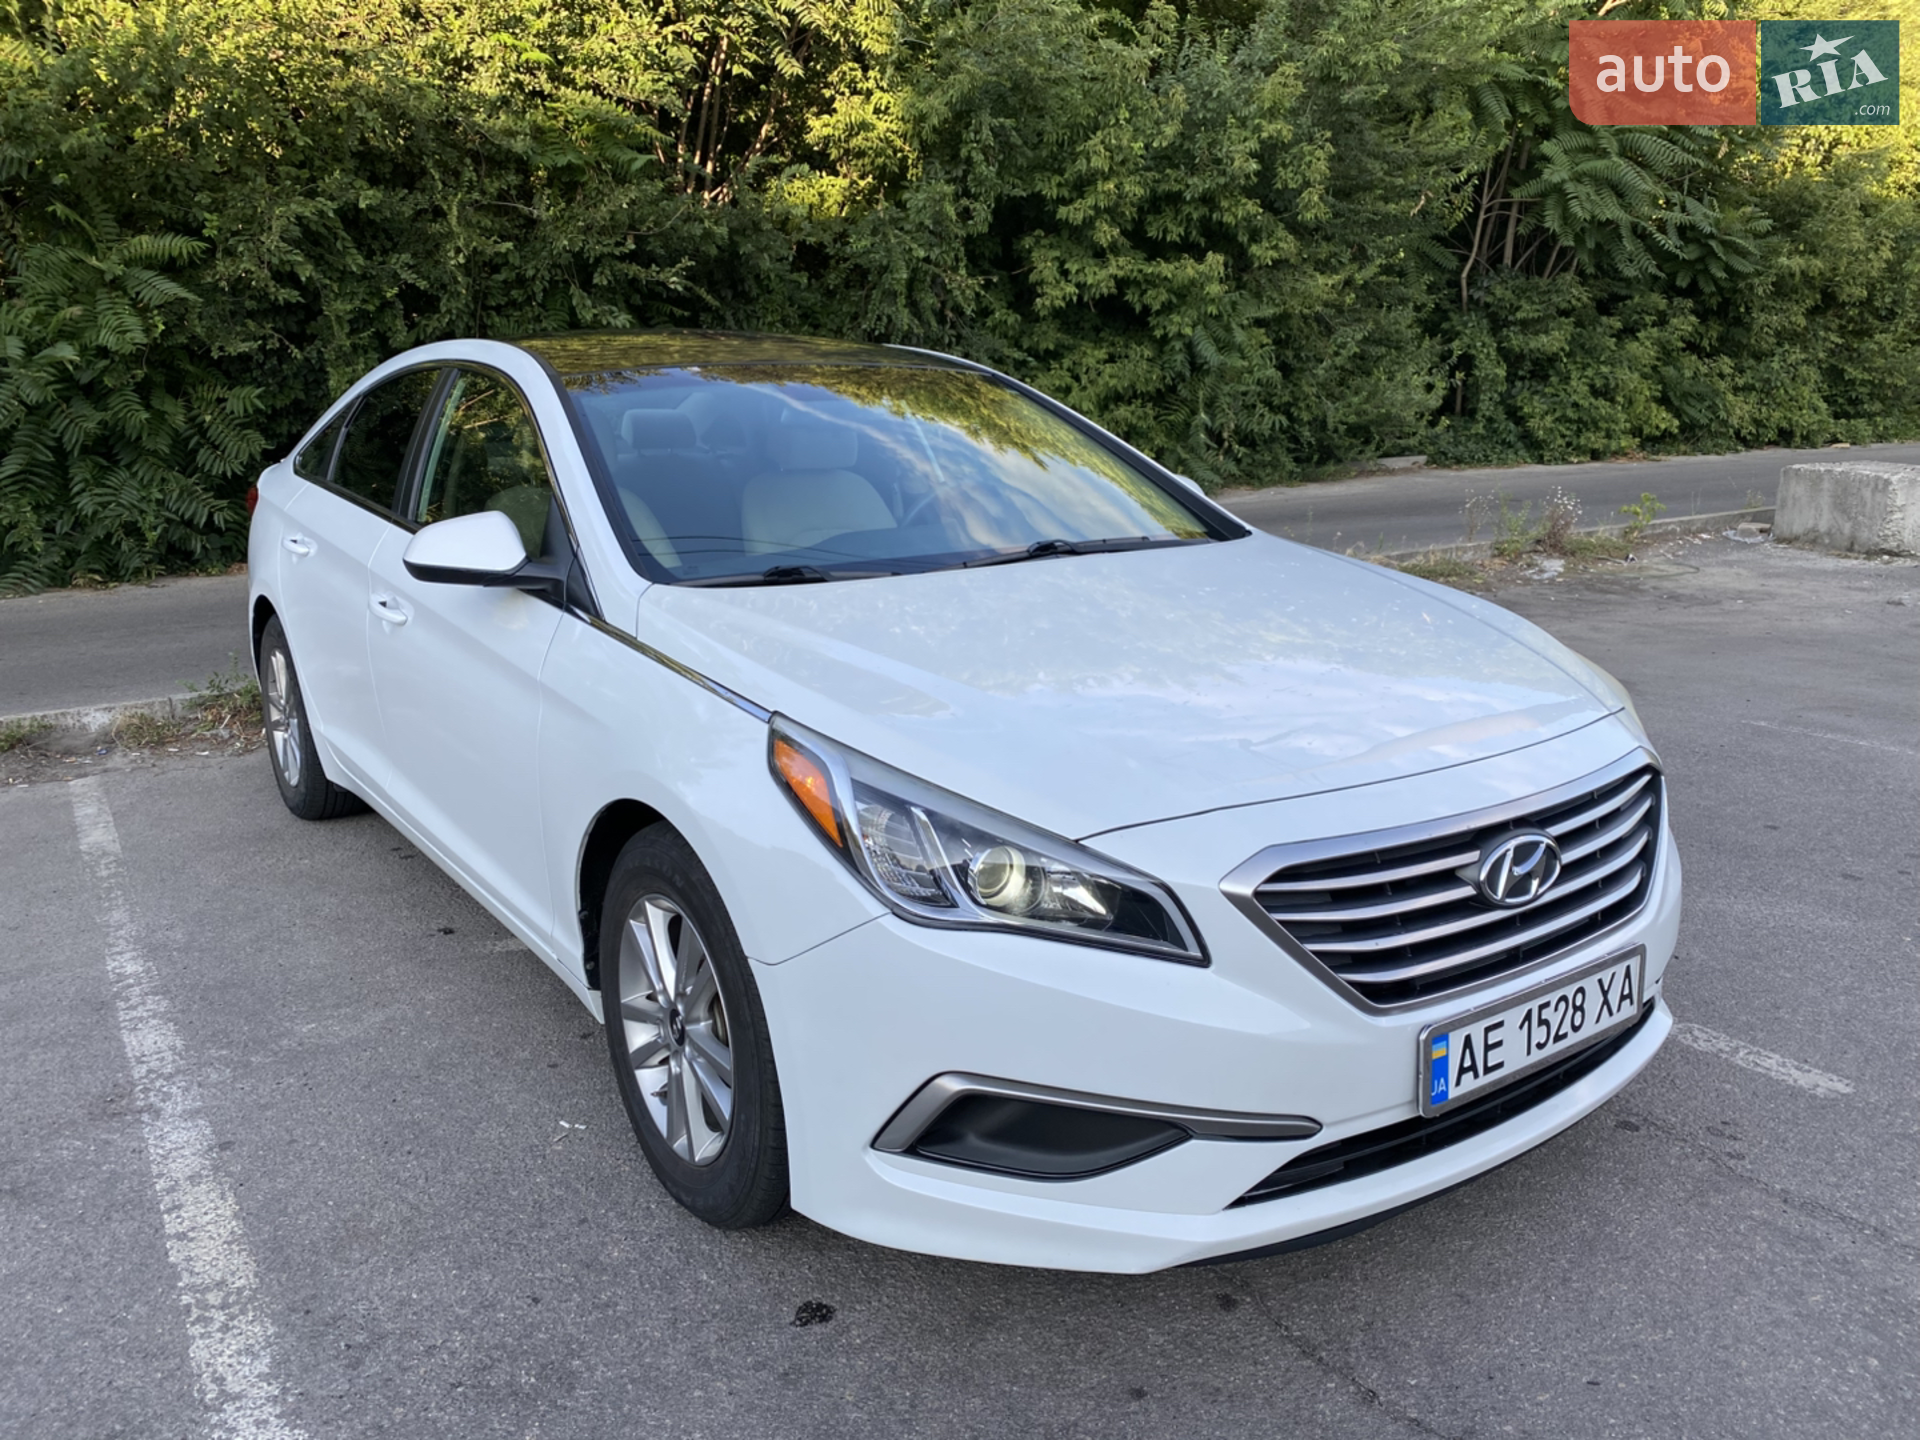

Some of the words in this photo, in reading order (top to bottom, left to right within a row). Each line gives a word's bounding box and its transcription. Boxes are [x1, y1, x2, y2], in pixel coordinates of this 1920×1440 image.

[1454, 1019, 1505, 1088] AE
[1518, 986, 1586, 1057] 1528
[1595, 964, 1635, 1025] XA
